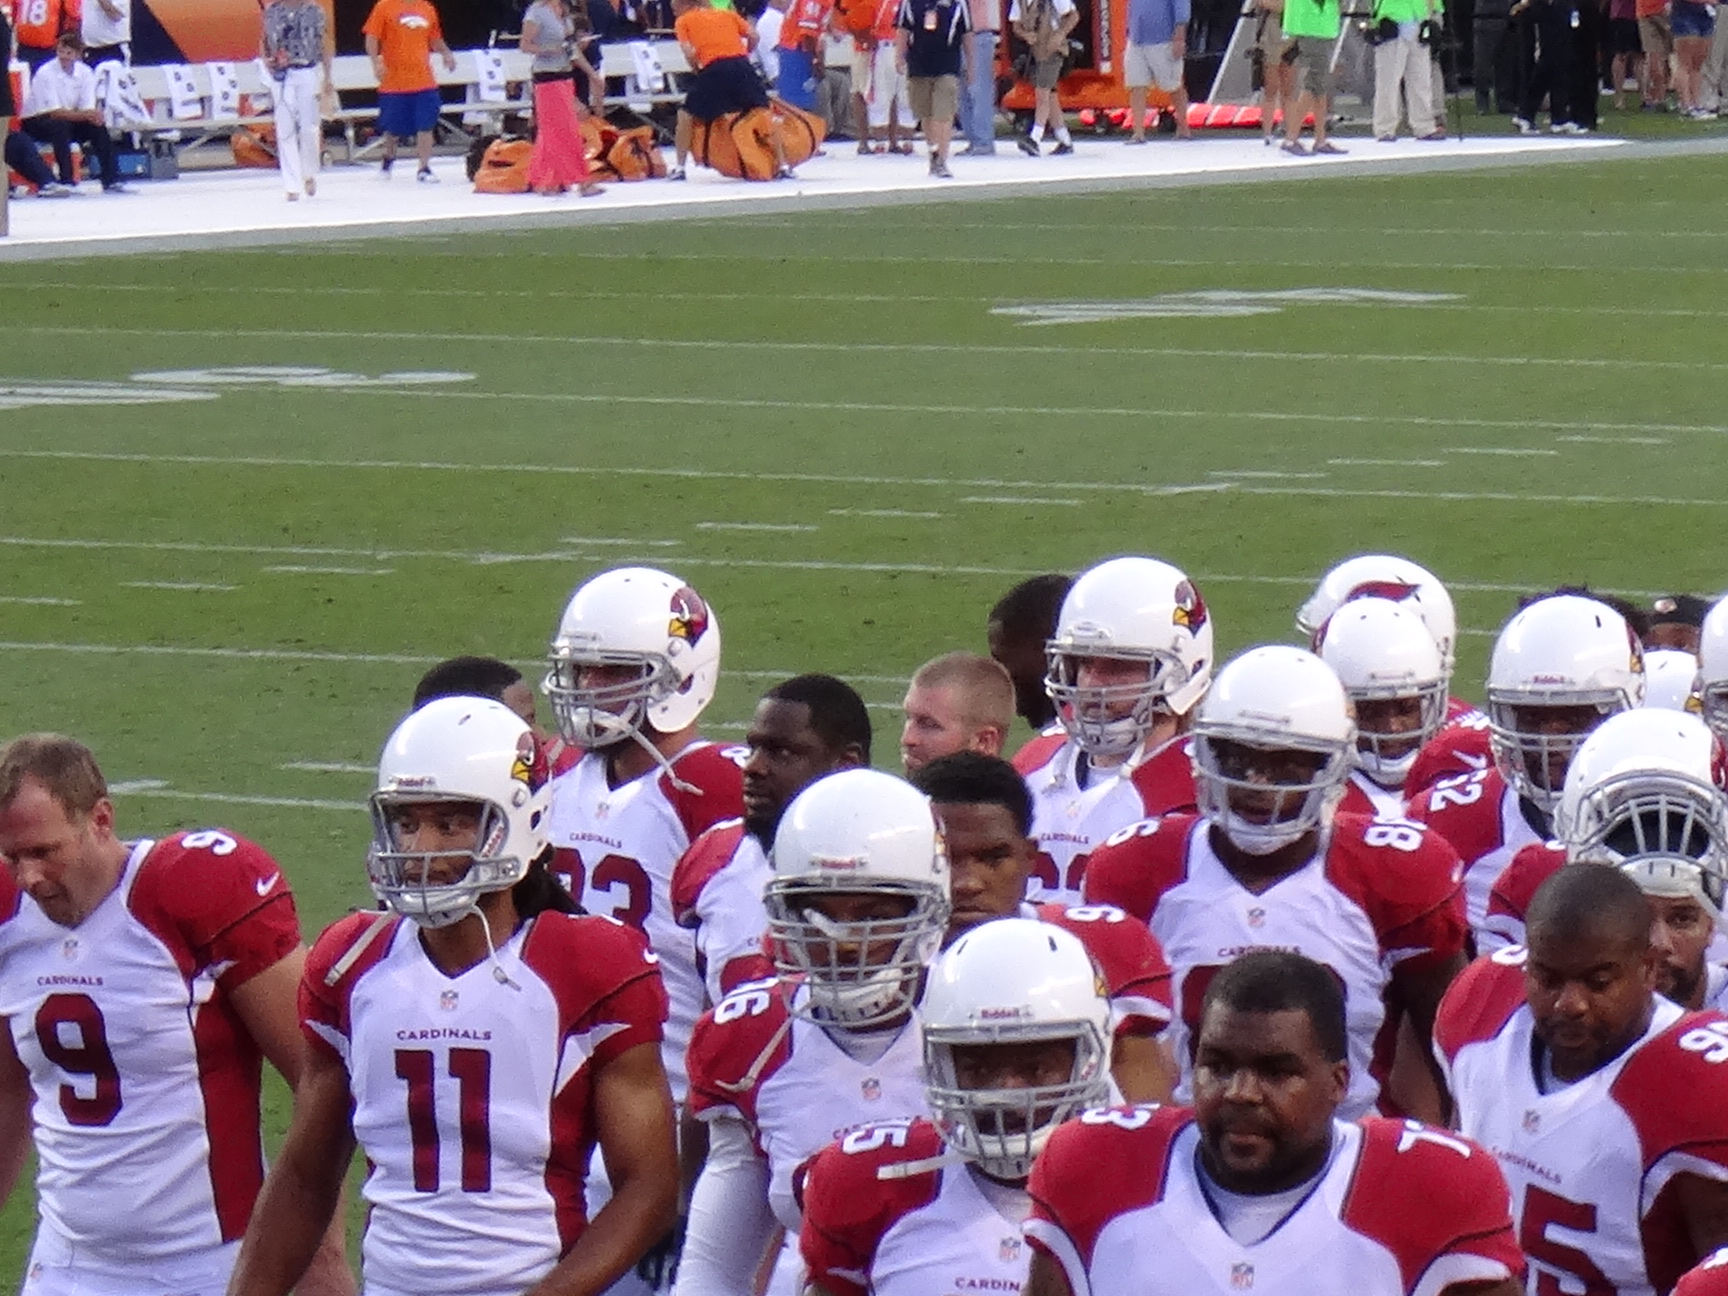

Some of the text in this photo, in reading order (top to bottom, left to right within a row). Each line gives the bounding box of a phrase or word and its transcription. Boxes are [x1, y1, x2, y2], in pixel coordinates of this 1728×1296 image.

[1363, 819, 1425, 852] 8
[714, 980, 778, 1025] 6
[396, 1029, 493, 1041] CARDINALS
[36, 993, 122, 1127] 9
[395, 1048, 491, 1192] 11
[1080, 1103, 1159, 1131] 3
[841, 1119, 911, 1155] 5
[1396, 1117, 1472, 1158] 7
[955, 1277, 1021, 1292] CARDIN
